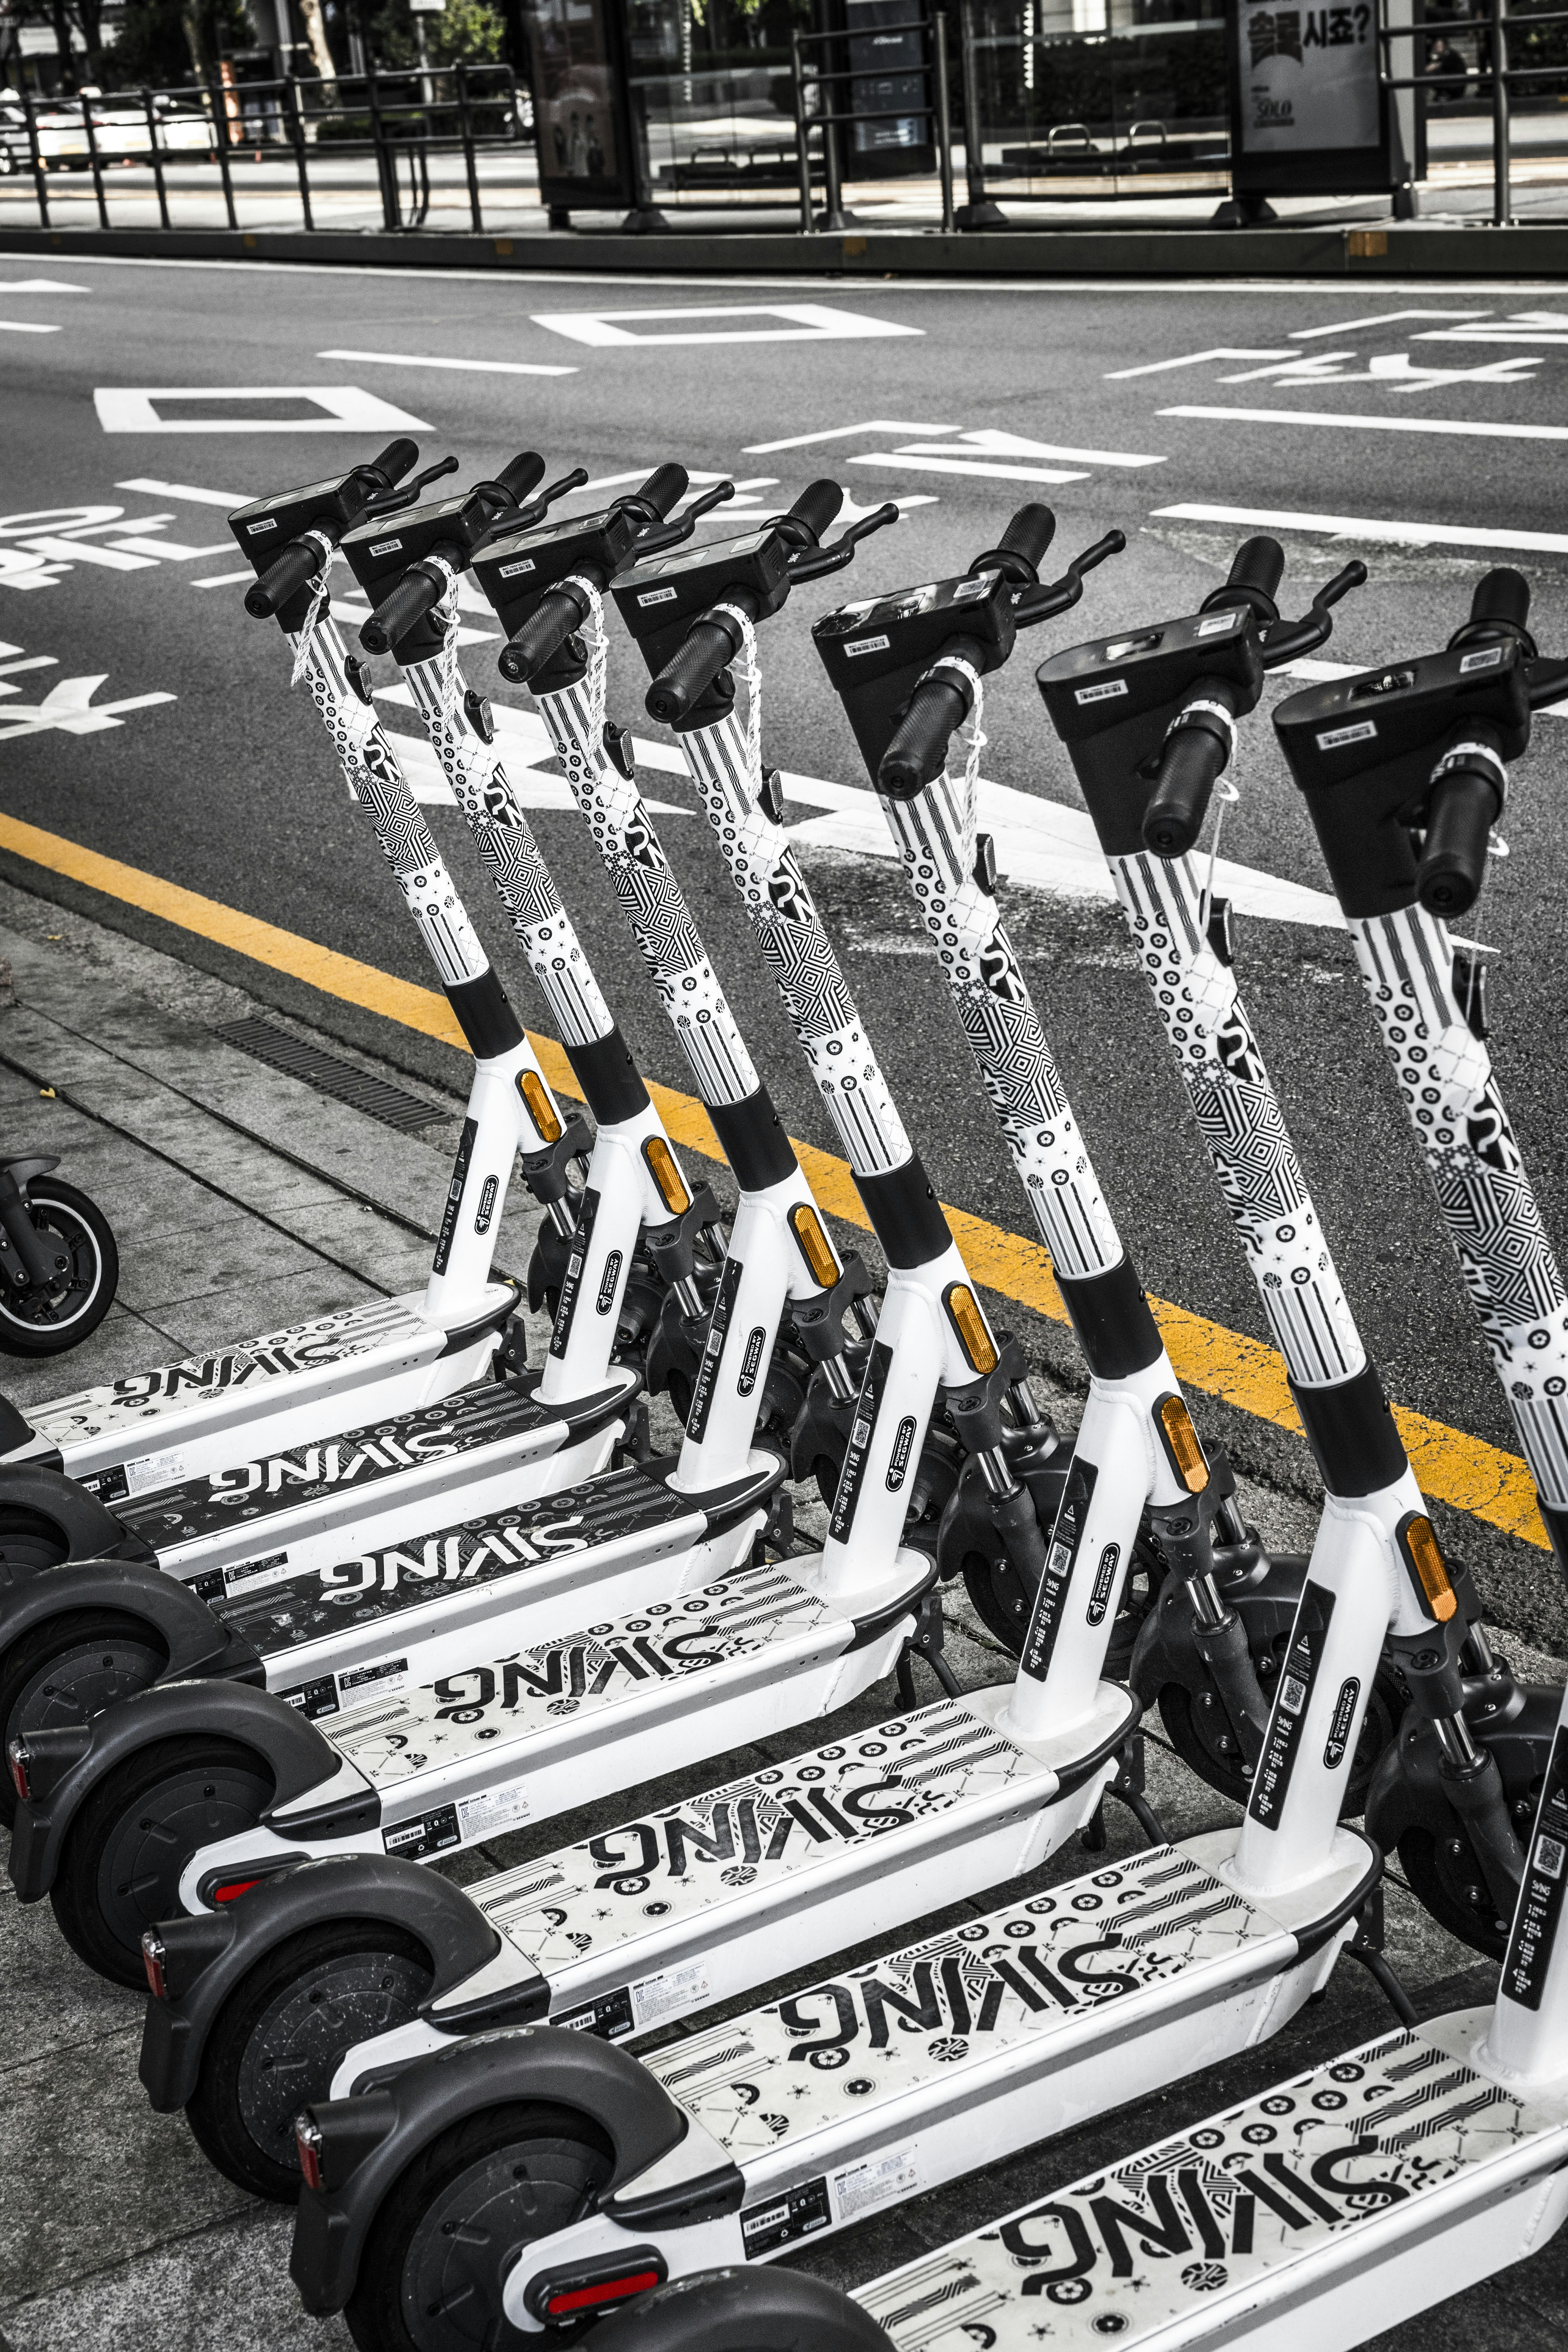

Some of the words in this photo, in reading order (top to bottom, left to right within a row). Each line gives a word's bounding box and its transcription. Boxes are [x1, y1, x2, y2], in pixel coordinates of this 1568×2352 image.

[594, 655, 603, 670] SWING
[485, 1183, 495, 1215] SEGWAY
[604, 1267, 612, 1293] POWERED
[608, 1259, 618, 1294] SEGWAY
[112, 1339, 341, 1405] SWING
[745, 1344, 754, 1373] POWERED
[749, 1336, 761, 1374] SEGWAY
[209, 1426, 458, 1502] SWING
[849, 1451, 860, 1462] SWING
[895, 1435, 905, 1466] POWERED
[903, 1425, 907, 1434] BY
[899, 1426, 912, 1467] SEGWAY
[319, 1516, 590, 1601] SWING
[1096, 1564, 1107, 1598] POWERED
[1105, 1553, 1110, 1562] BY
[1100, 1554, 1115, 1599] SEGWAY
[1046, 1577, 1059, 1592] SWING
[431, 1626, 723, 1719] SWING
[1277, 1715, 1292, 1731] SWING
[1338, 1689, 1355, 1738] SEGWAY
[591, 1774, 919, 1889] SWING
[779, 1932, 1140, 2061] SWING
[1000, 2134, 1409, 2295] SWING
